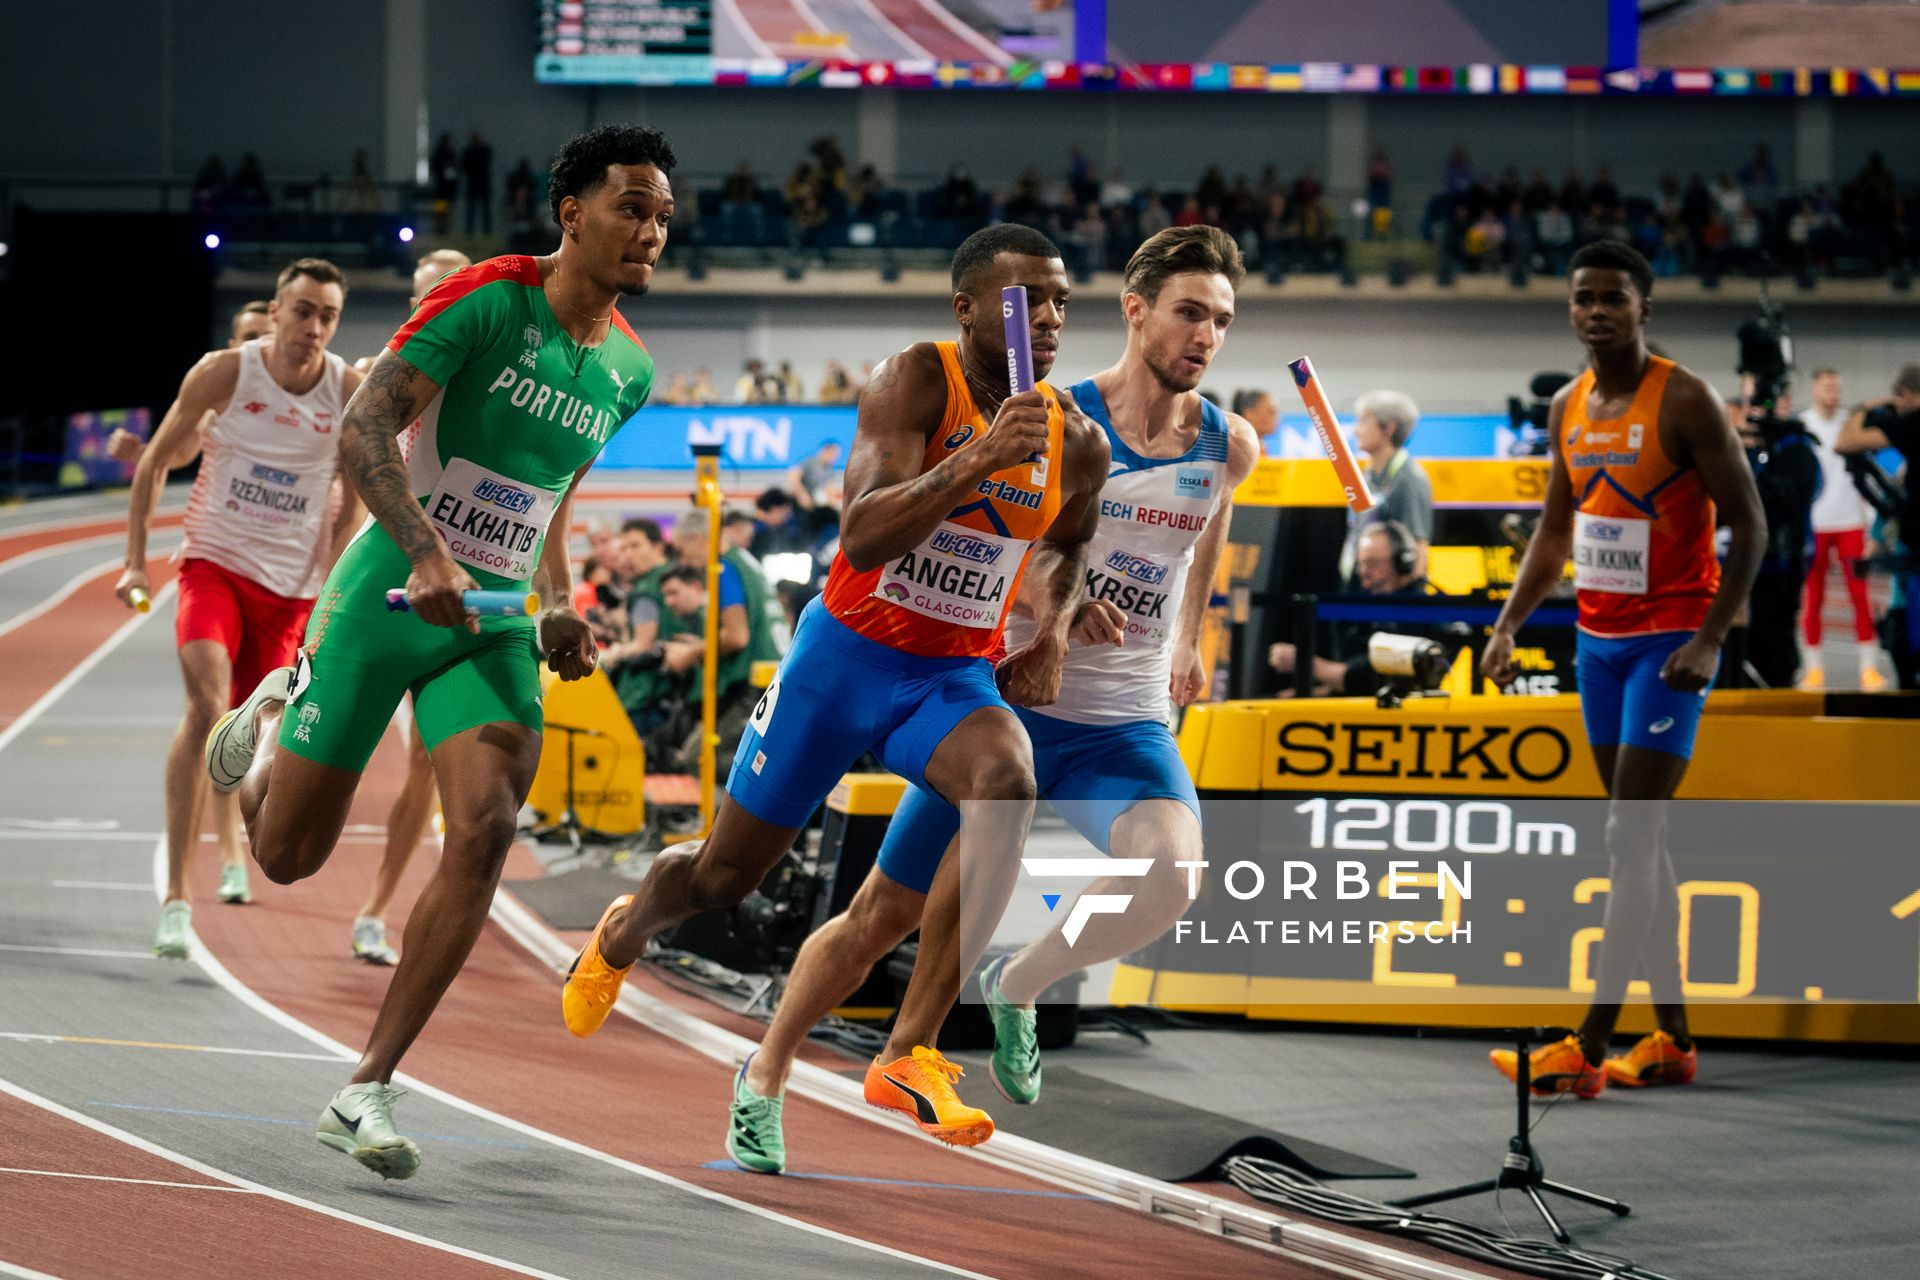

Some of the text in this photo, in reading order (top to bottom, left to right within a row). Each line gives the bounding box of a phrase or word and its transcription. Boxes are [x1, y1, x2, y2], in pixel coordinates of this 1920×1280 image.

[1003, 301, 1013, 318] 6
[518, 354, 537, 371] FPA
[487, 366, 611, 444] PORTUGAL
[1313, 414, 1338, 462] MONDO
[472, 478, 536, 515] HI-CHEW
[977, 478, 1044, 511] erland
[432, 492, 538, 553] ELKHATIB
[1100, 500, 1208, 532] ECH REPUBLIC
[450, 540, 527, 575] GLASGOW 24
[929, 529, 1004, 566] HI-CHEW
[893, 551, 1006, 602] ANGELA
[1105, 549, 1169, 585] HI-CHEW
[914, 595, 996, 623] GLASGOW 24
[1086, 568, 1169, 620] KRSEK
[293, 729, 311, 744] FPA
[1276, 720, 1571, 783] SEIKO
[1294, 797, 1577, 856] 1200m
